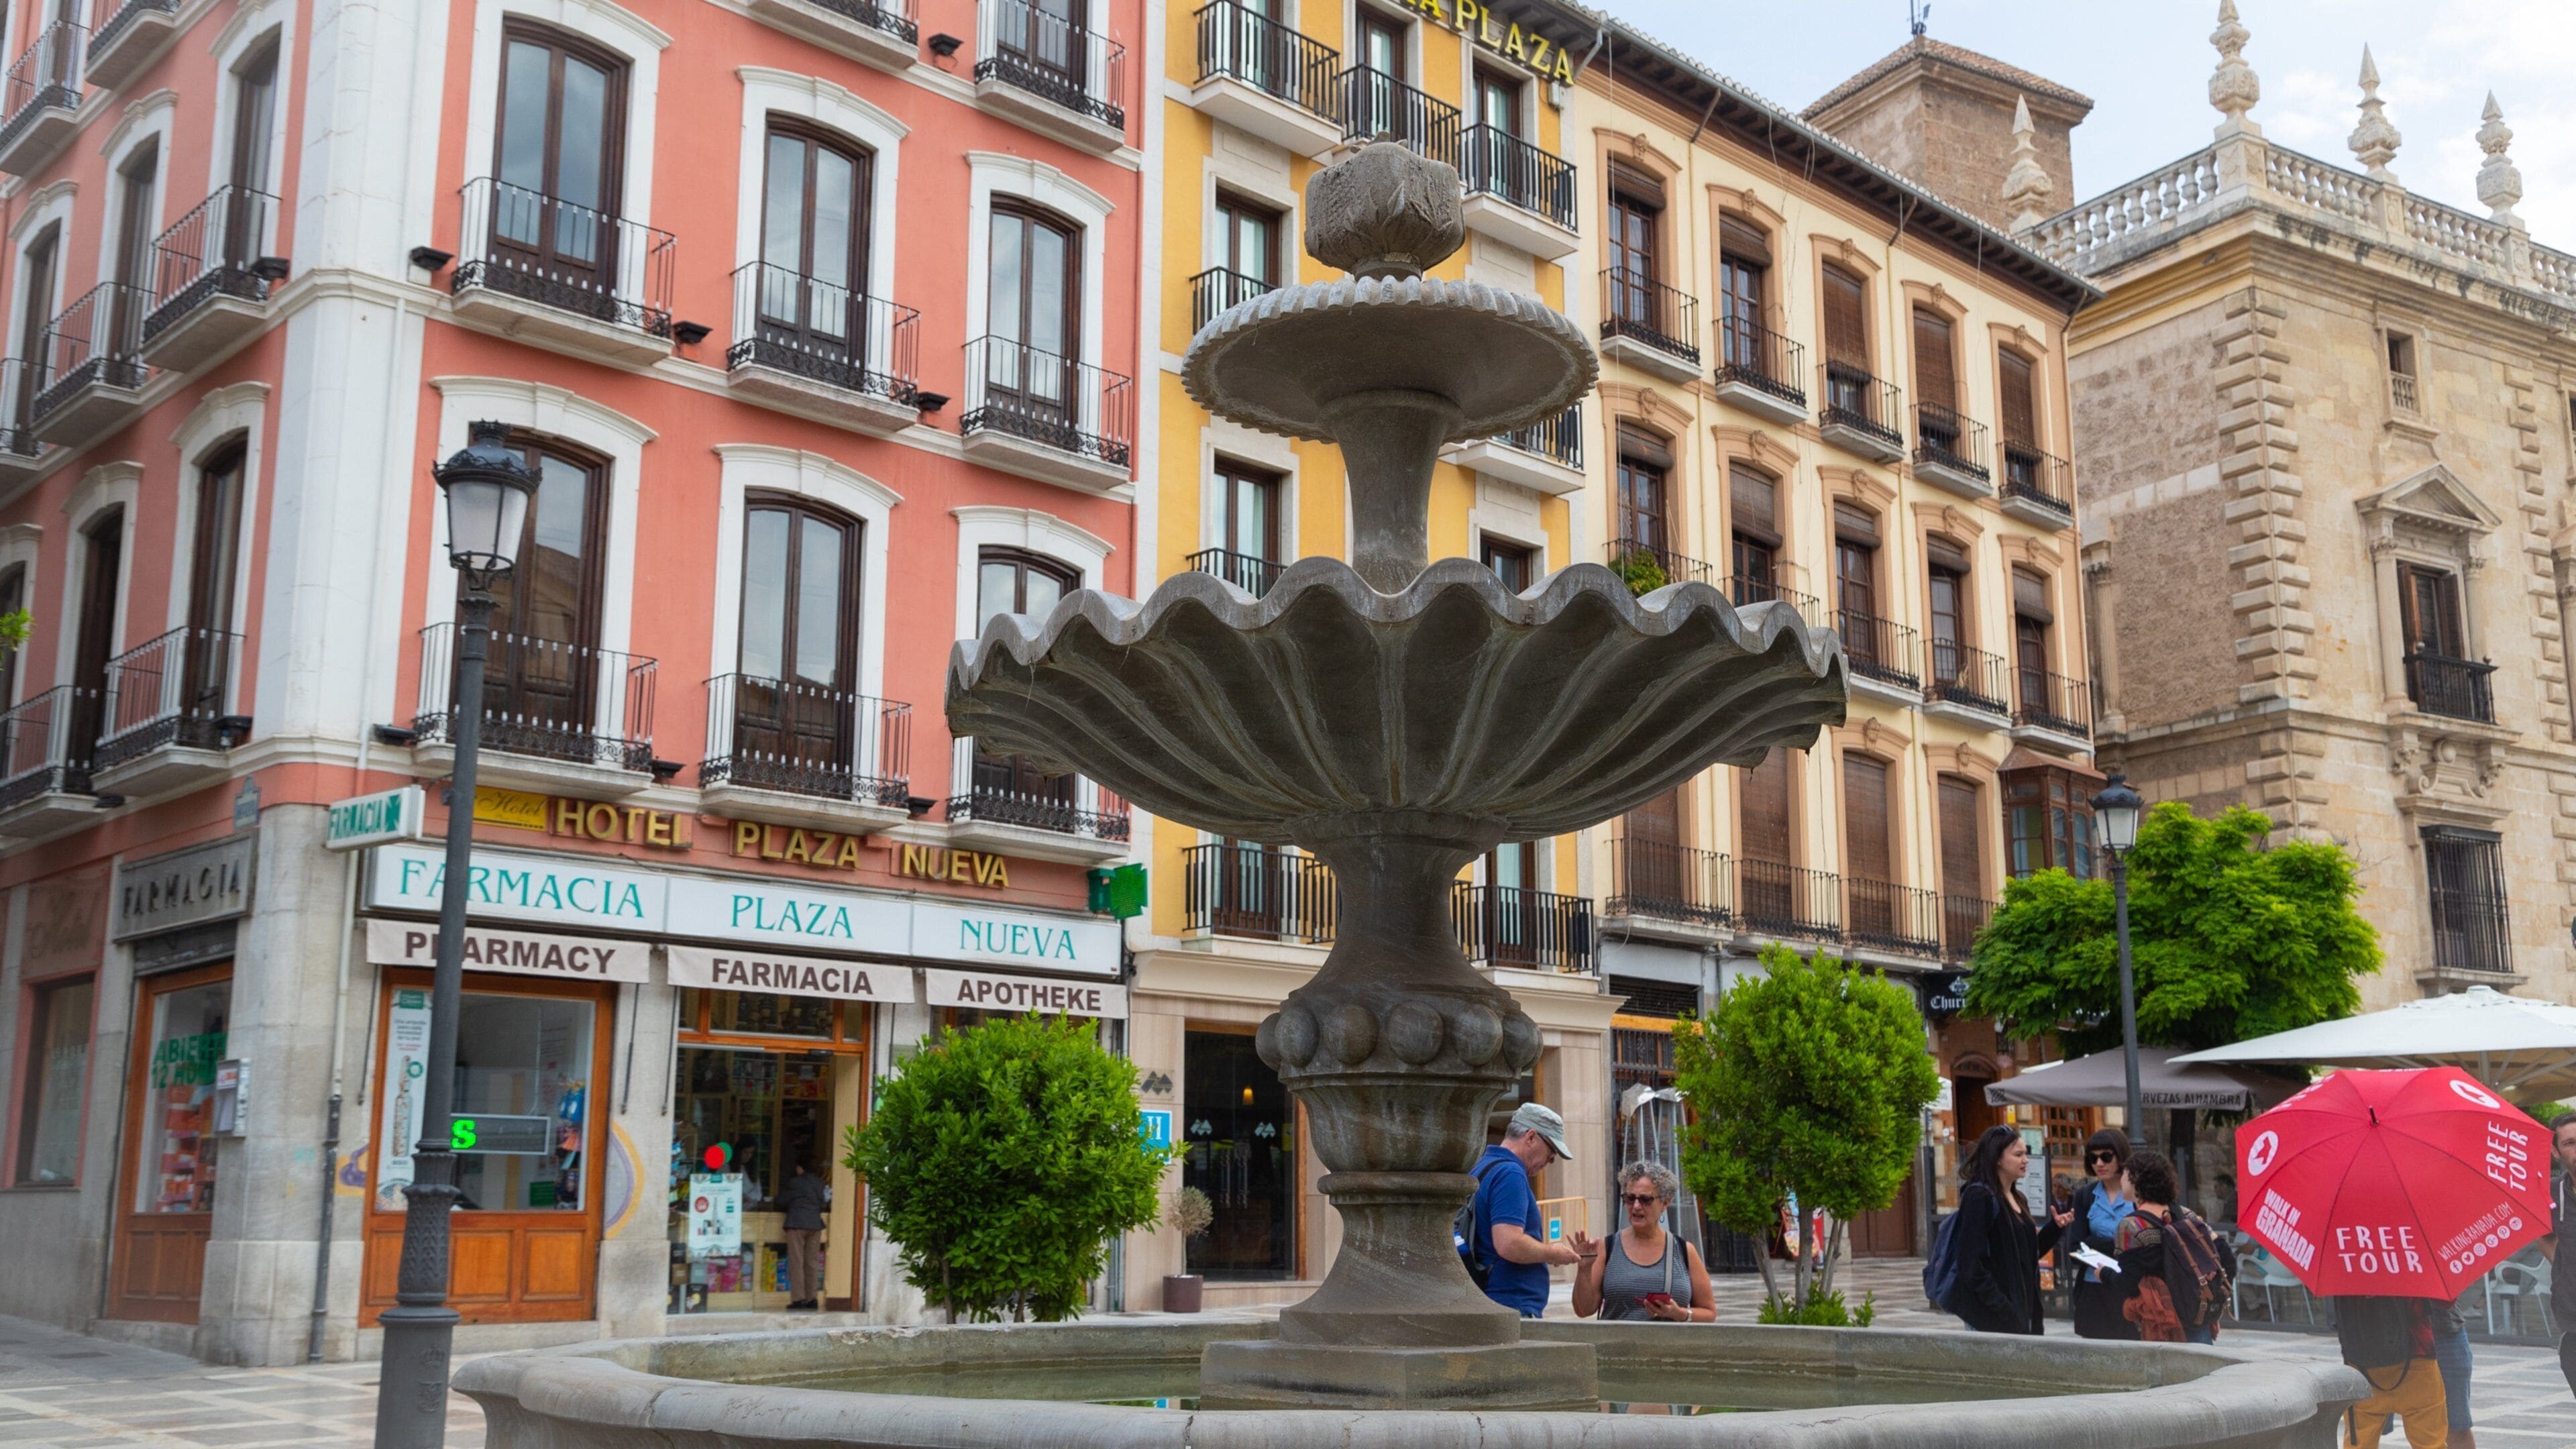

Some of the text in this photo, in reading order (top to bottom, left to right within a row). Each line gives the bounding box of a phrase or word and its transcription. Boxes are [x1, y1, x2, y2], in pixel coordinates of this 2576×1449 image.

[1455, 0, 1574, 85] PLAZA
[327, 799, 385, 841] FARMACIA
[556, 798, 1010, 888] HOTEL PLAZA NUEVA
[123, 859, 240, 919] FARMACIA
[731, 894, 854, 939] PLAZA
[959, 918, 1077, 960] NUEVA
[711, 957, 873, 996] FARMACIA
[957, 978, 1102, 1012] APOTHEKE
[2485, 1120, 2508, 1184] FREE
[2509, 1130, 2528, 1191] TOUR
[2255, 1205, 2315, 1271] GRANADA
[2264, 1188, 2301, 1228] WALK IN
[2336, 1226, 2415, 1250] FREE
[2338, 1250, 2423, 1274] TOUR
